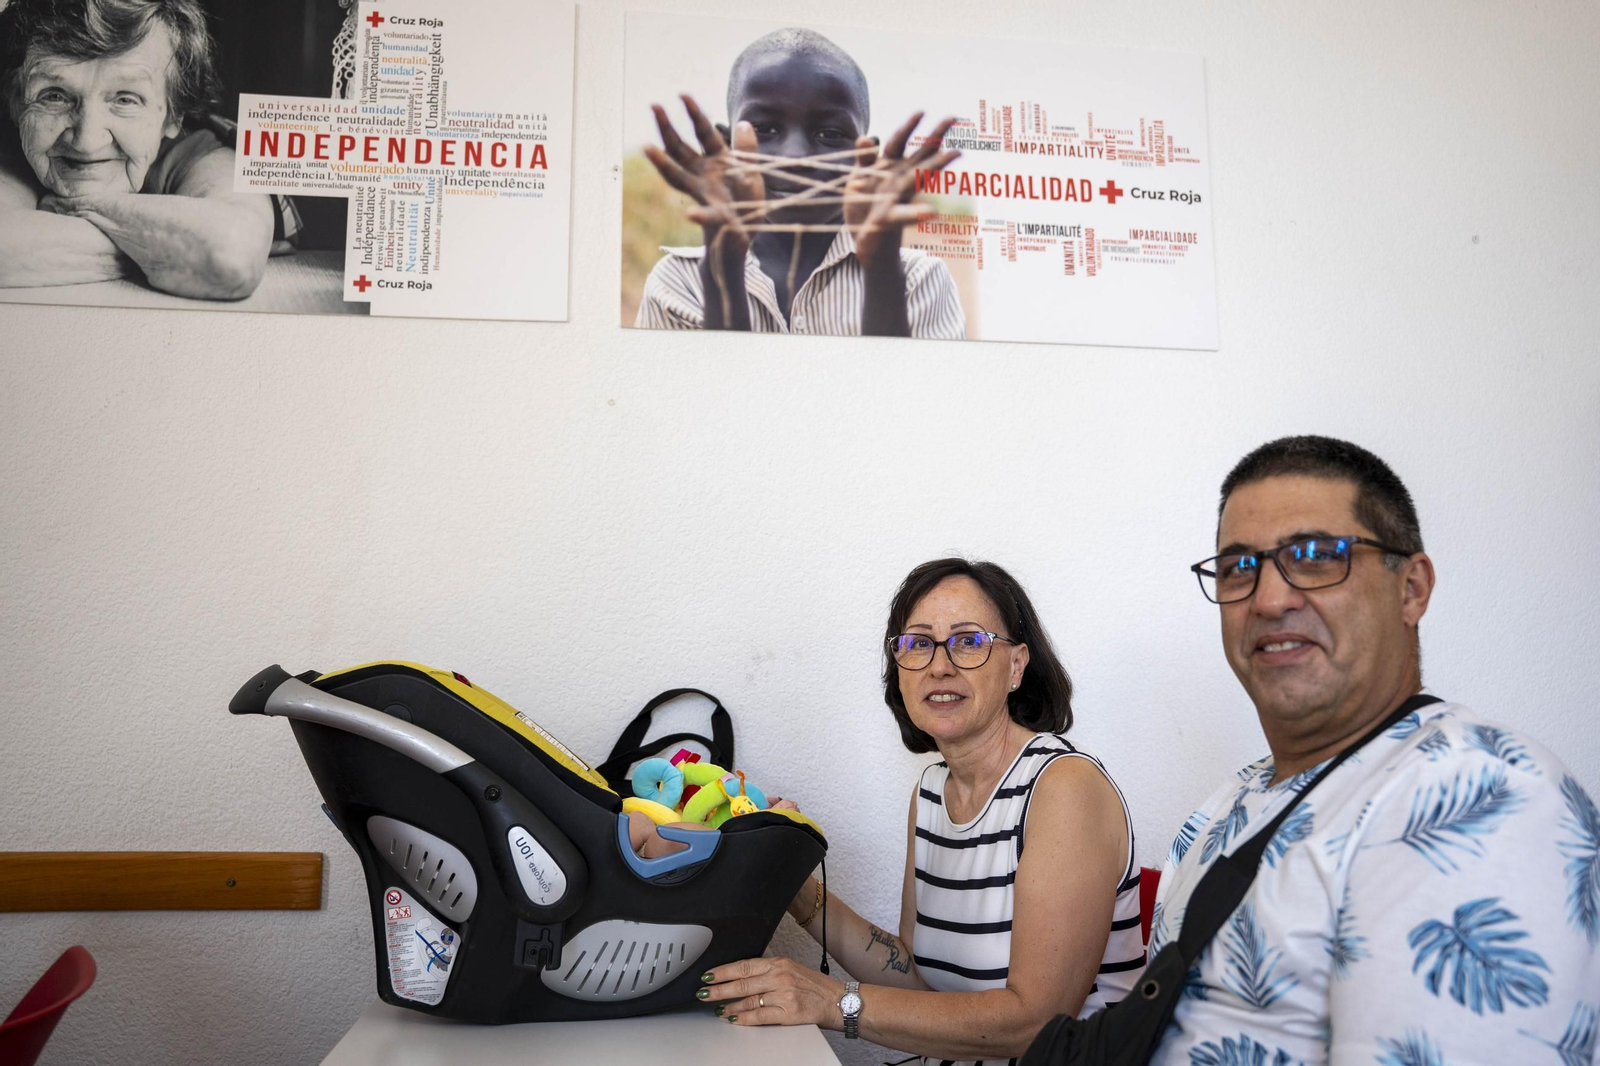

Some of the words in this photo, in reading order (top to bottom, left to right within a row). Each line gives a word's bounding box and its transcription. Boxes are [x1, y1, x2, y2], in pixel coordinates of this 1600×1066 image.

[389, 16, 416, 26] Cruz
[419, 17, 444, 29] Roja
[383, 31, 429, 40] voluntariado
[382, 42, 428, 52] humanidad
[381, 55, 428, 66] neutralità
[380, 65, 415, 76] unidad
[426, 33, 444, 130] Unabhängigkeit
[380, 86, 409, 94] gizateria
[258, 101, 358, 114] universalidad
[412, 68, 426, 135] neutrality
[248, 109, 330, 123] independence
[361, 105, 406, 115] unidade
[405, 93, 415, 136] Humanidade
[446, 110, 496, 119] voluntariat
[336, 115, 406, 127] neutralidade
[448, 118, 515, 129] neutralidad
[497, 113, 548, 122] umanità
[1033, 103, 1041, 134] HUMANIDAD
[257, 121, 319, 133] volunteering
[329, 124, 343, 133] Le
[348, 124, 405, 136] bénévolat
[518, 122, 547, 131] unità
[1002, 105, 1014, 153] UNIVERSALIDADE
[426, 130, 479, 139] boluntariotza
[481, 129, 548, 141] independentzia
[243, 130, 548, 170] INDEPENDENCIA
[945, 139, 1001, 152] UNPARTEILICHKEIT
[1014, 141, 1104, 159] IMPARTIALITY
[1103, 133, 1117, 161] UNITÉ
[1153, 120, 1166, 167] IMPARZIALITÀ
[250, 159, 302, 169] imparzialità
[306, 160, 328, 169] unitat
[329, 161, 405, 175] voluntariado
[242, 168, 325, 181] independència
[327, 172, 382, 183] L'humanité
[406, 166, 457, 177] humanity
[458, 169, 491, 177] unitate
[493, 170, 546, 179] neutraltasuna
[249, 179, 300, 188] neutralitate
[302, 181, 354, 190] universalidade
[393, 179, 424, 192] unity
[444, 175, 546, 190] Independência
[915, 168, 1093, 203] IMPARCIALIDAD
[425, 176, 436, 205] Unité
[445, 188, 499, 198] universality
[499, 191, 544, 199] imparcialitat
[1130, 187, 1165, 201] Cruz
[1169, 190, 1202, 205] Roja
[435, 177, 444, 226] imparcialidade
[355, 186, 364, 234] neutralité
[361, 186, 377, 266] Indépendance
[375, 187, 387, 272] Freiwilligenarbeit
[917, 222, 979, 236] NEUTRALITY
[1017, 223, 1082, 238] L'IMPARTIALITÉ
[396, 200, 406, 272] neutralidade
[405, 203, 419, 273] Neutralität
[419, 206, 431, 275] indipendenza
[1006, 221, 1017, 262] UNIVERSALITAT
[1129, 228, 1198, 244] IMPARCIALIDADE
[353, 237, 362, 250] La
[384, 231, 394, 268] Einheit
[433, 228, 441, 271] Humanidade
[909, 244, 975, 254] IMPARTIALITATE
[1168, 244, 1189, 252] EINHEIT
[976, 238, 984, 271] HUMANIDADE
[1062, 240, 1075, 276] UMANITÀ
[1084, 228, 1097, 277] VOLUNTARIADO
[377, 279, 404, 289] Cruz
[407, 280, 433, 291] Roja
